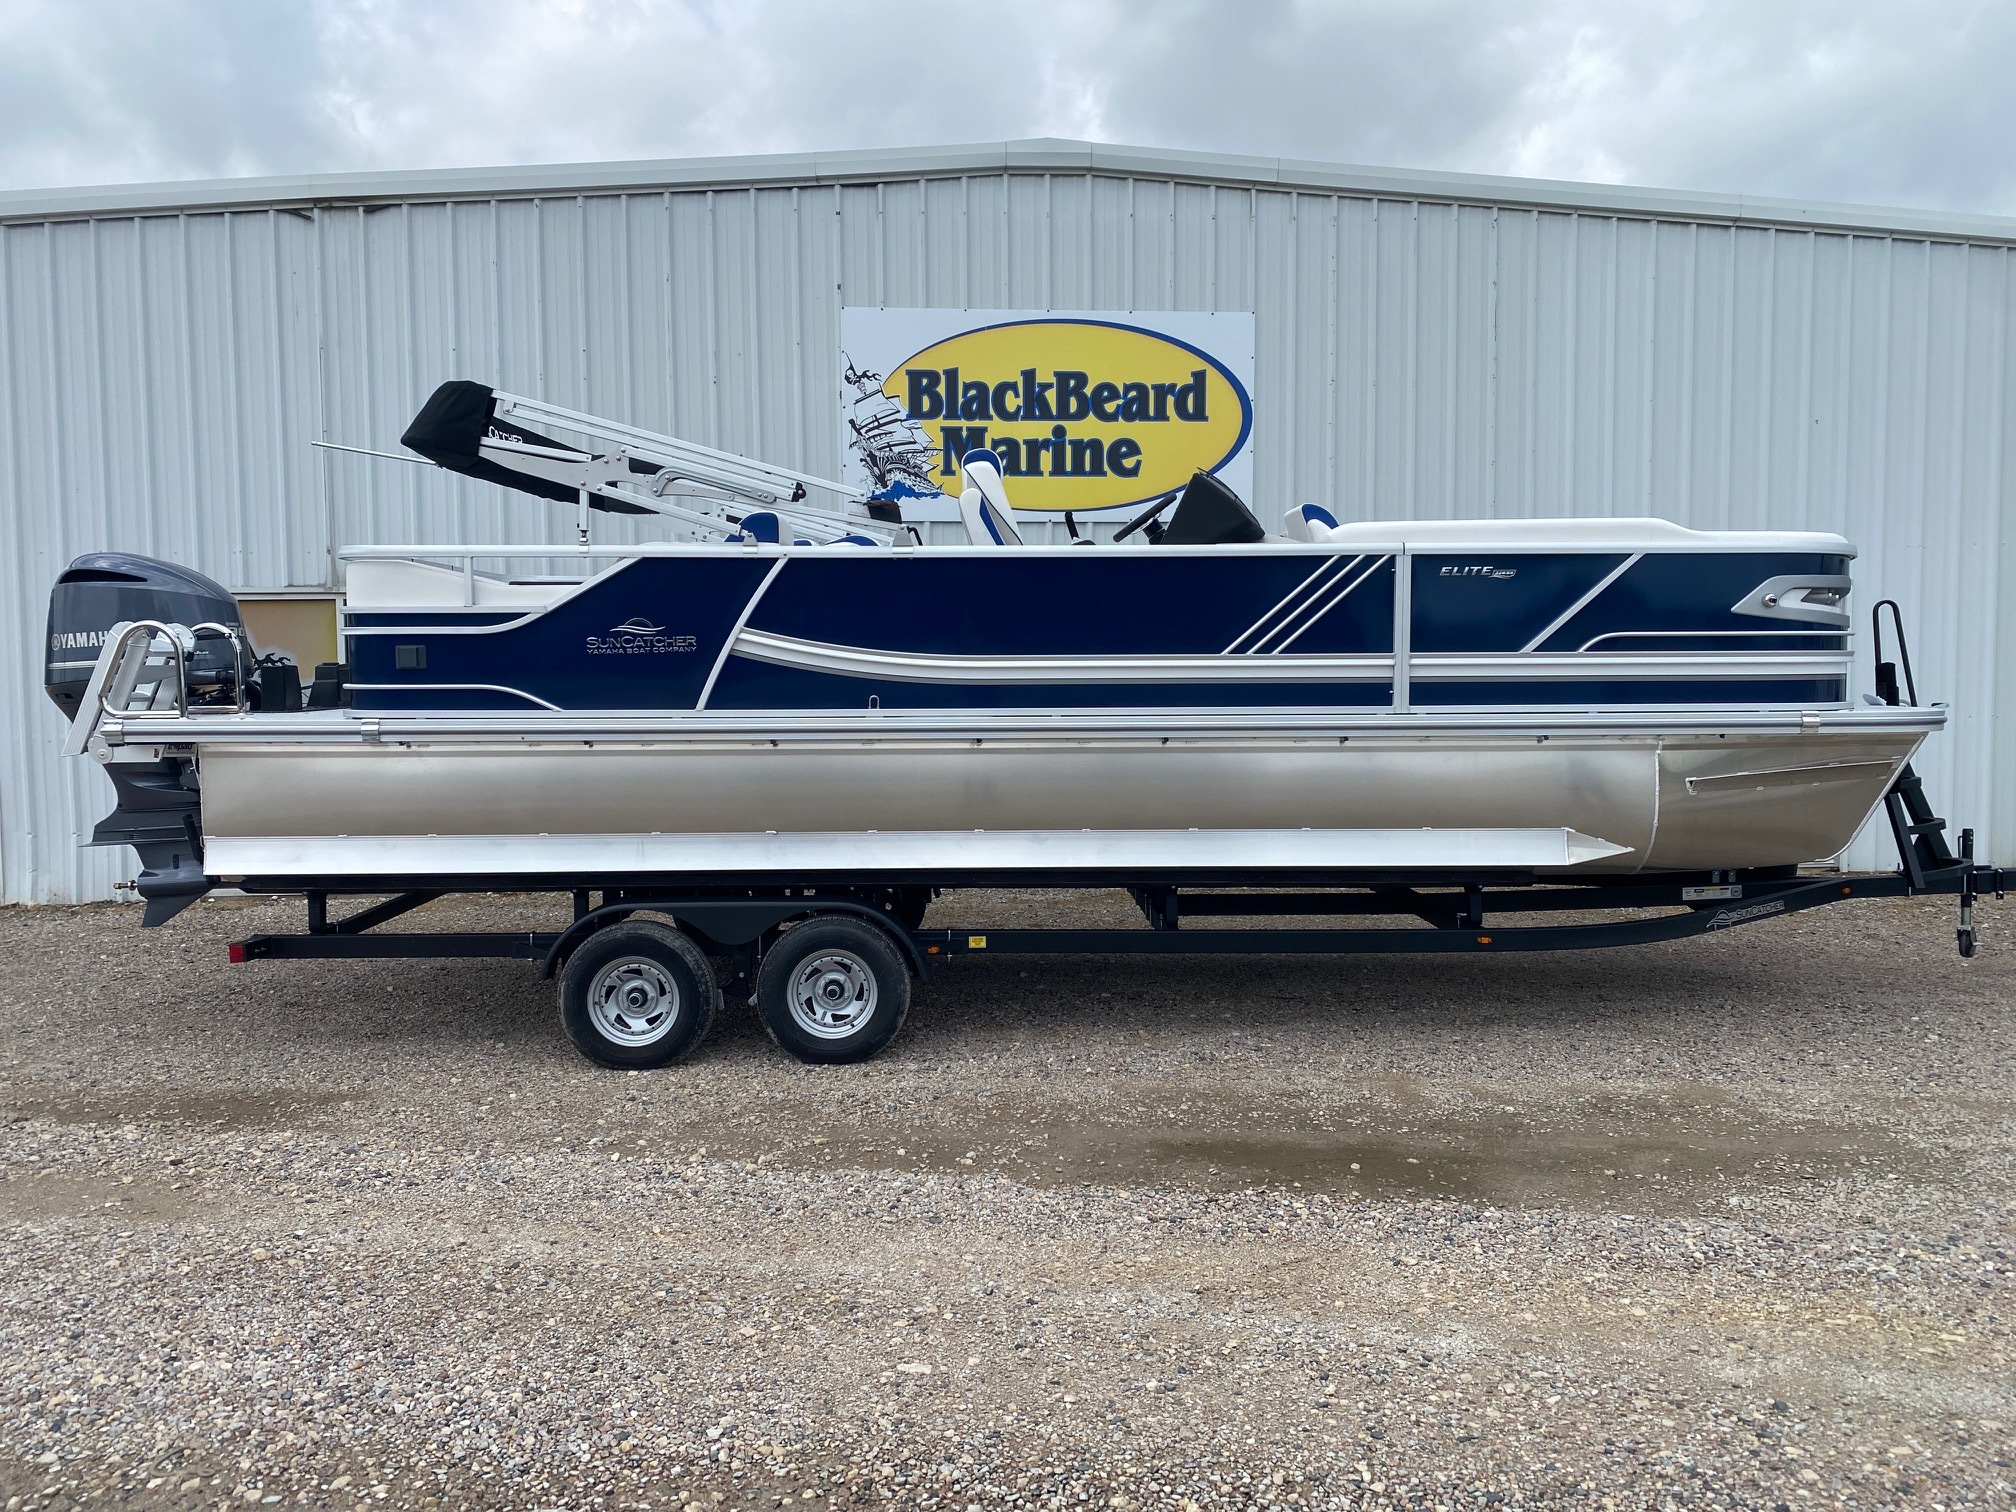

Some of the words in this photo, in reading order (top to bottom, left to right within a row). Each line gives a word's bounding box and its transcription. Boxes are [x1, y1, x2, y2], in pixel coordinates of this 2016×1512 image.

[905, 366, 1209, 422] BlackBeard
[940, 425, 1142, 478] Marine
[1440, 566, 1493, 576] ELITE
[60, 630, 108, 649] YAMAH
